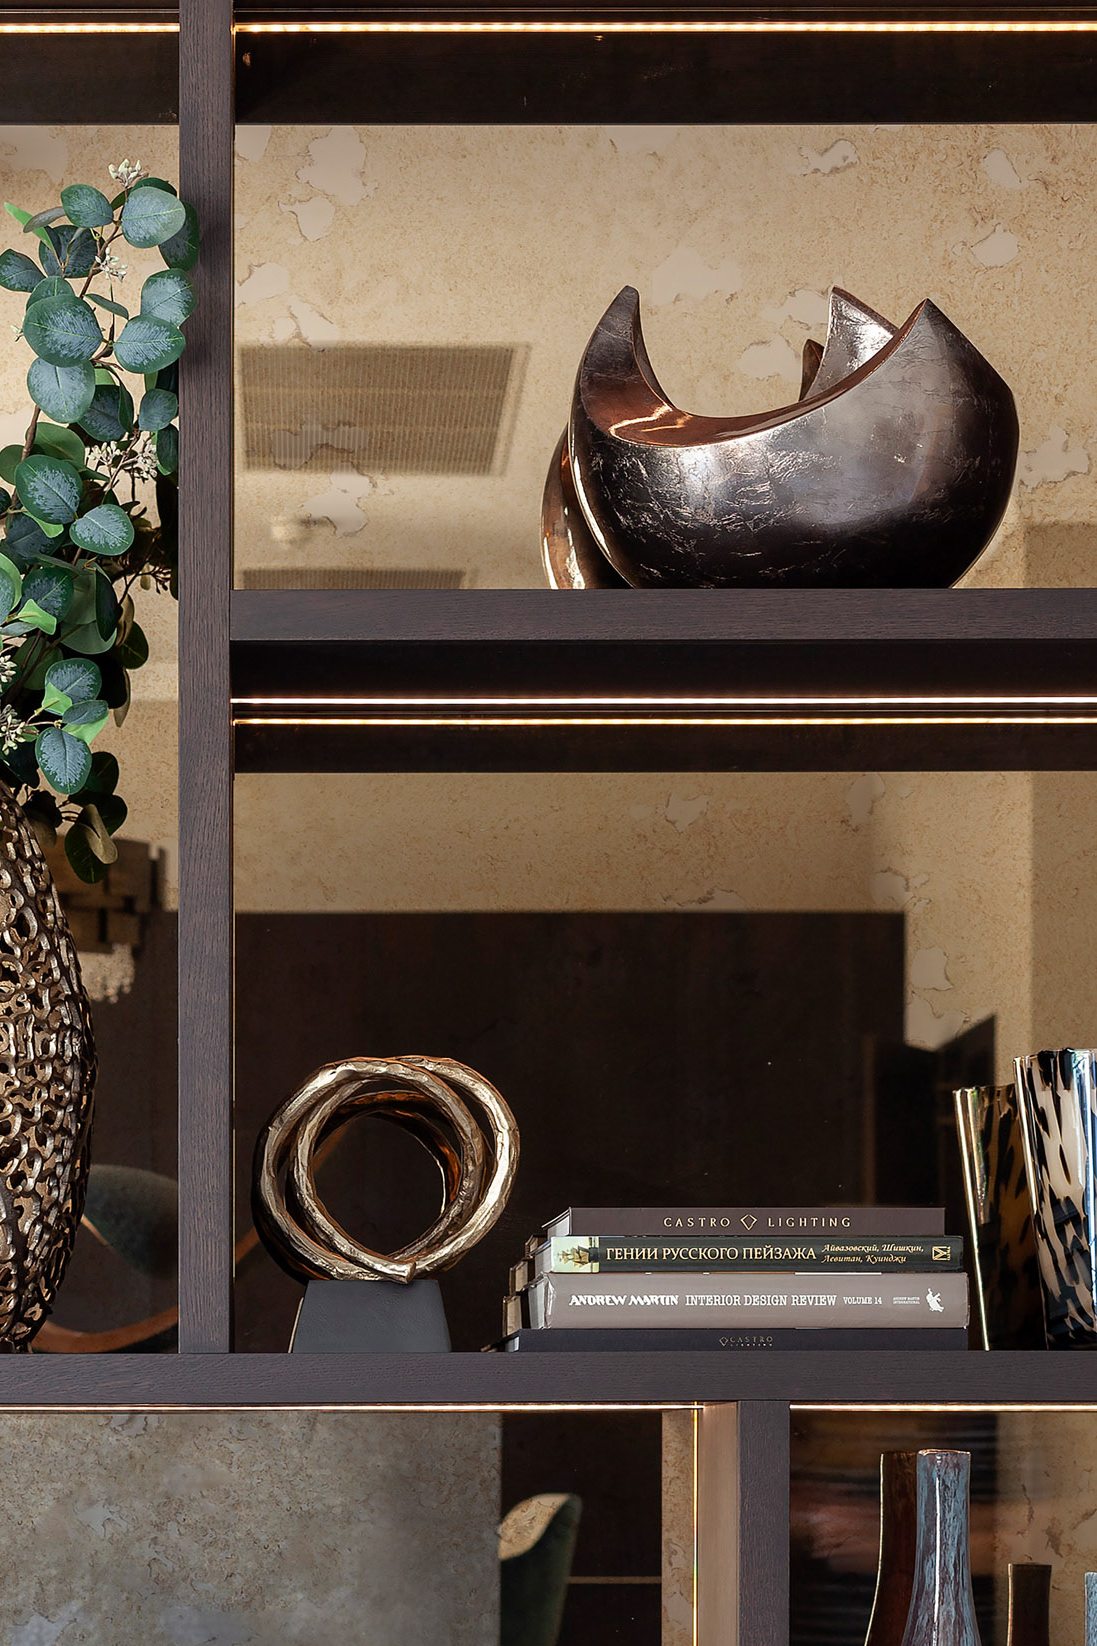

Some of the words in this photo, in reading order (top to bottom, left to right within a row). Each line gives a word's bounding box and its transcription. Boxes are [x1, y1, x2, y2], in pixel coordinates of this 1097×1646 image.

[663, 1217, 730, 1227] CASTRO
[767, 1217, 852, 1227] LIGHTING
[606, 1247, 659, 1260] ГЕНИИ
[662, 1247, 739, 1260] РУССКОГО
[742, 1245, 817, 1260] ПЕЙЗАЖА
[821, 1243, 880, 1254] Айвазовский,
[881, 1243, 924, 1253] Шишкин,
[821, 1254, 863, 1264] Левитан,
[865, 1253, 907, 1265] Куинджи
[568, 1294, 628, 1306] ANDREW
[628, 1294, 680, 1306] MARTIN
[685, 1294, 742, 1306] INTERIOR
[743, 1294, 788, 1306] DESIGN
[790, 1294, 837, 1306] REVIEW
[843, 1296, 873, 1305] VOLUME
[874, 1296, 883, 1305] 14
[730, 1335, 773, 1343] CASTRO
